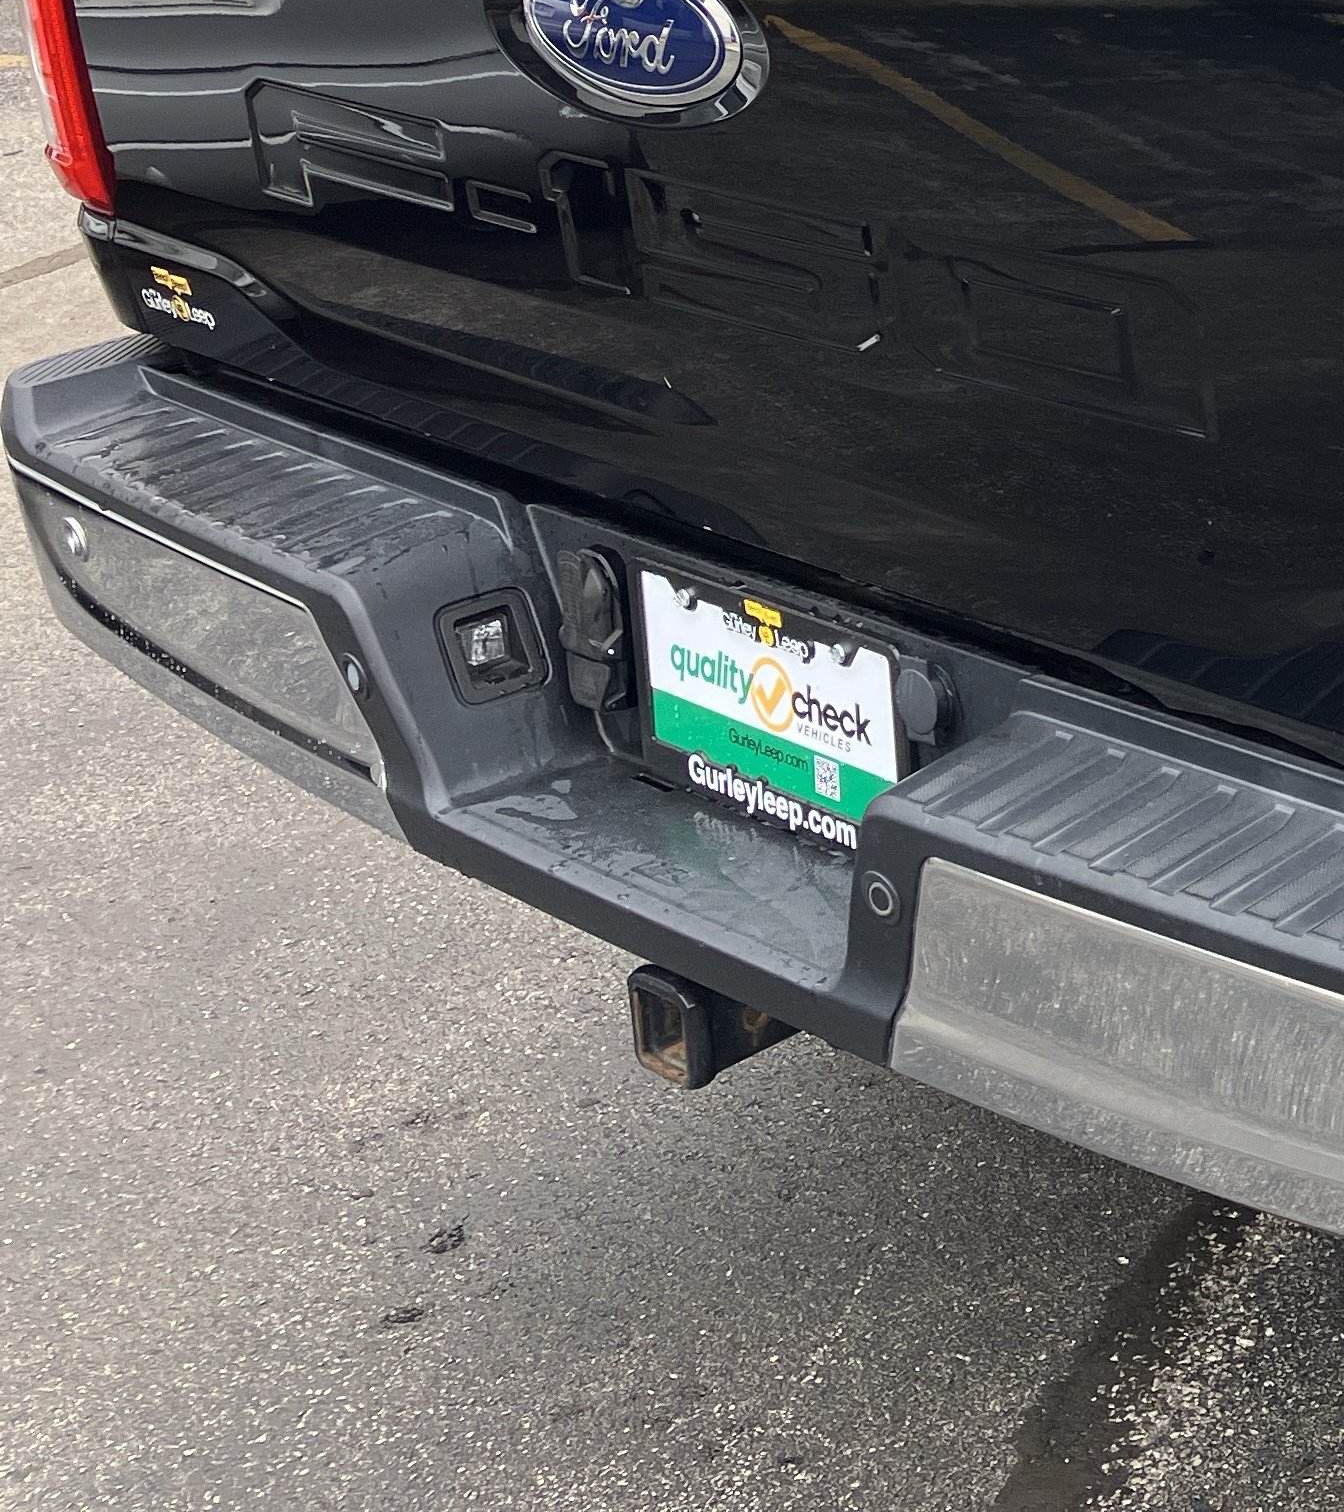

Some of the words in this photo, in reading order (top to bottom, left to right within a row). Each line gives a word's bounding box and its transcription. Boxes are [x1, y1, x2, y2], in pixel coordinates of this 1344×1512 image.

[670, 643, 755, 705] quality
[791, 684, 873, 746] check
[796, 722, 852, 753] VEHICLES
